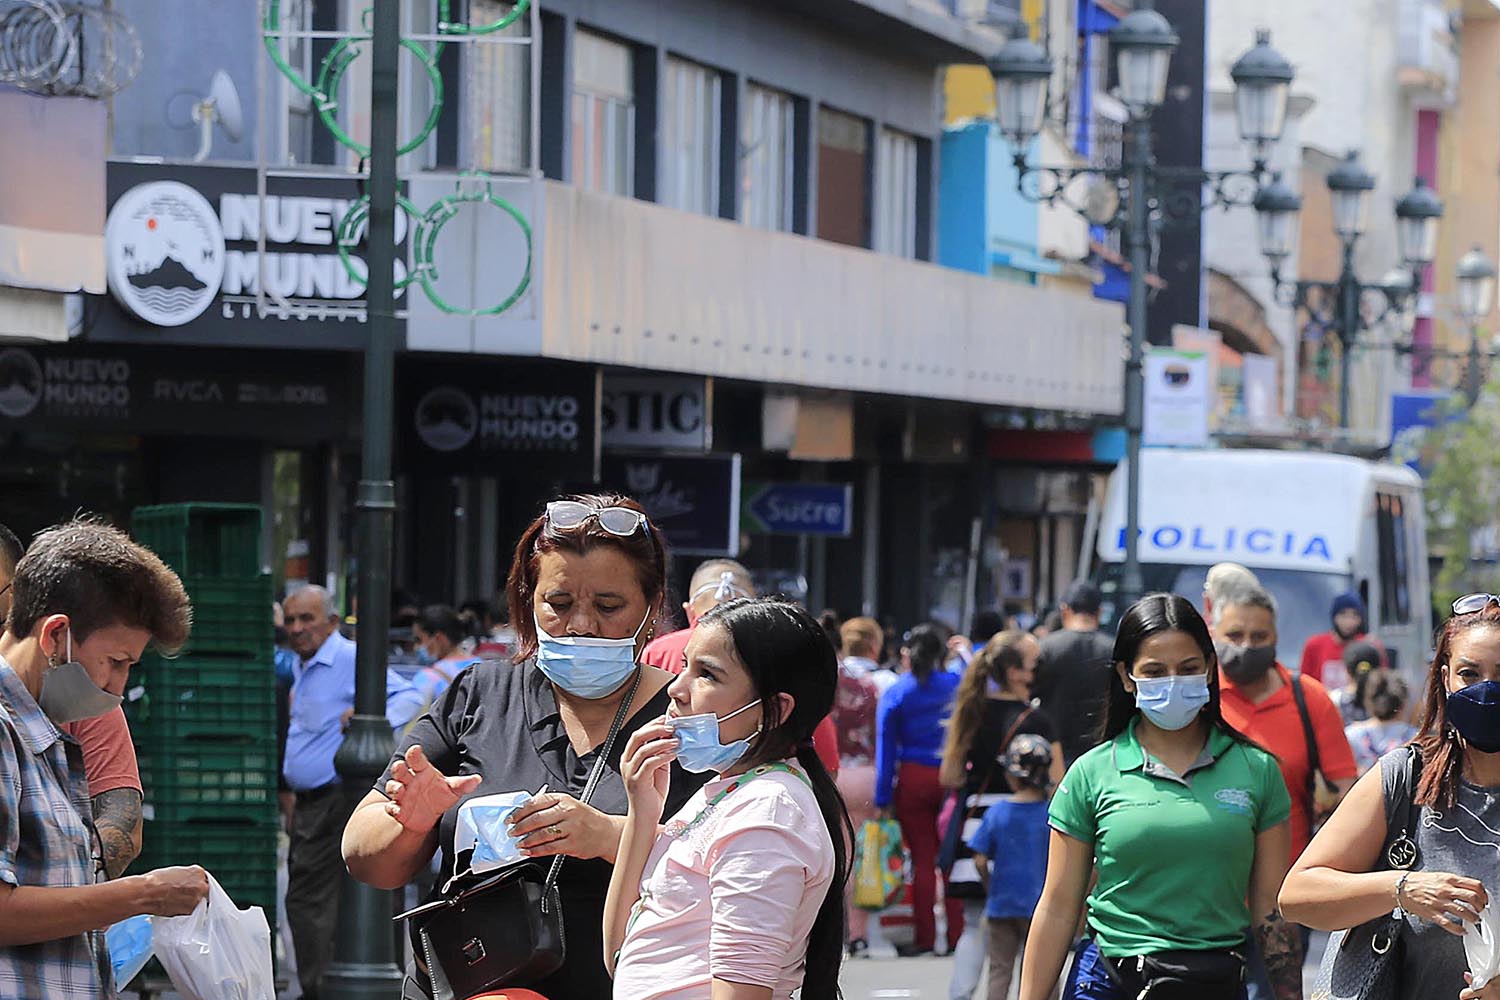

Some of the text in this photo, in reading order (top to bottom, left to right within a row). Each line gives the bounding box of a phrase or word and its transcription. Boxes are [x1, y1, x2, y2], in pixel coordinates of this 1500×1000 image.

[45, 359, 131, 381] NUEVO
[45, 383, 131, 405] MUNDO
[481, 396, 578, 417] NUEVO
[481, 418, 578, 440] MUNDO
[768, 496, 842, 525] Sucre
